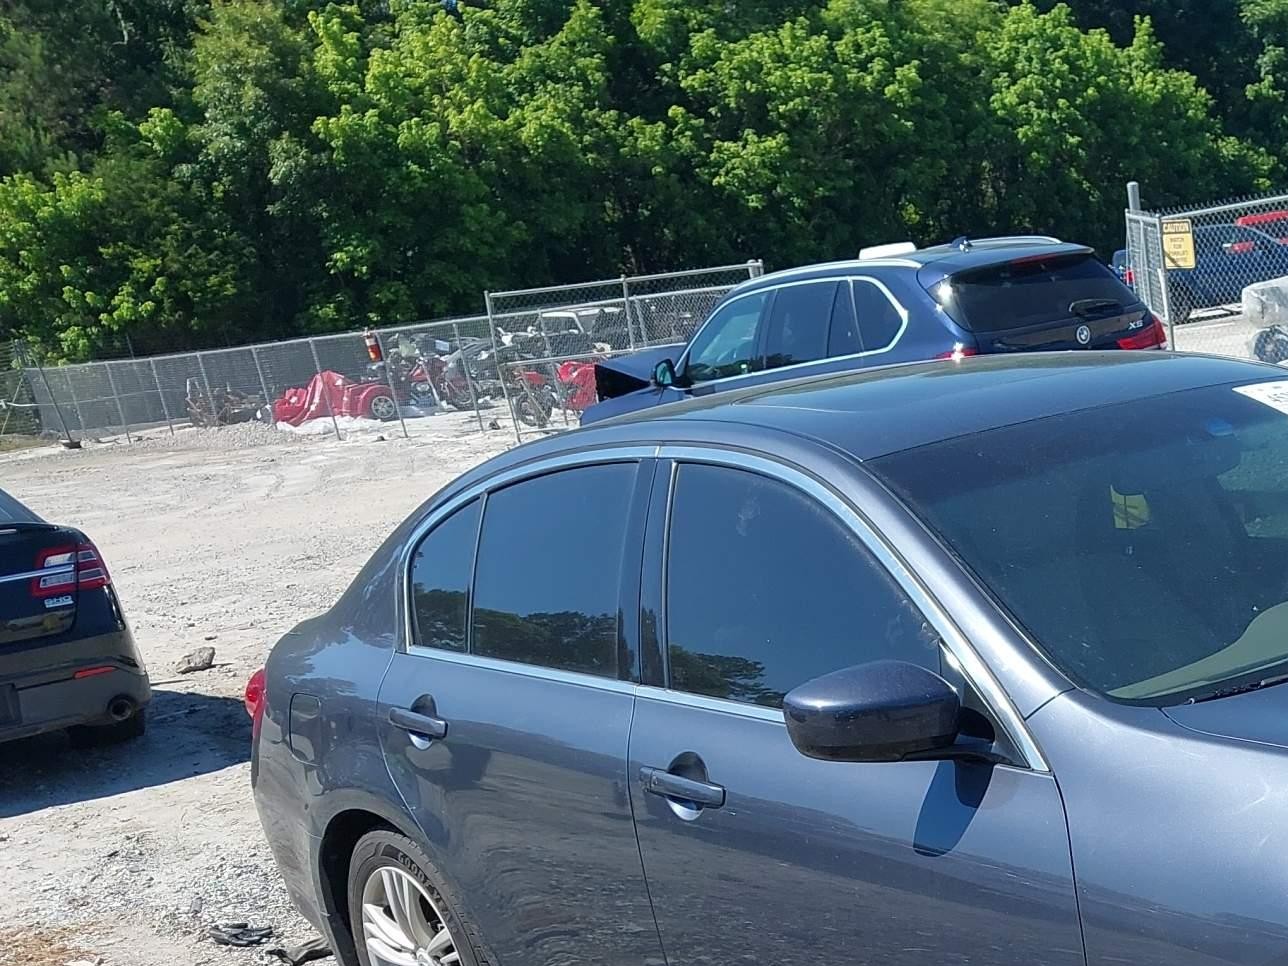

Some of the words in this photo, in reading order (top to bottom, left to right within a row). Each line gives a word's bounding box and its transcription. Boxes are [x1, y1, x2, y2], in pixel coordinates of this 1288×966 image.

[1163, 223, 1190, 233] CAUTION
[1128, 319, 1144, 330] X5
[44, 595, 73, 606] SHO
